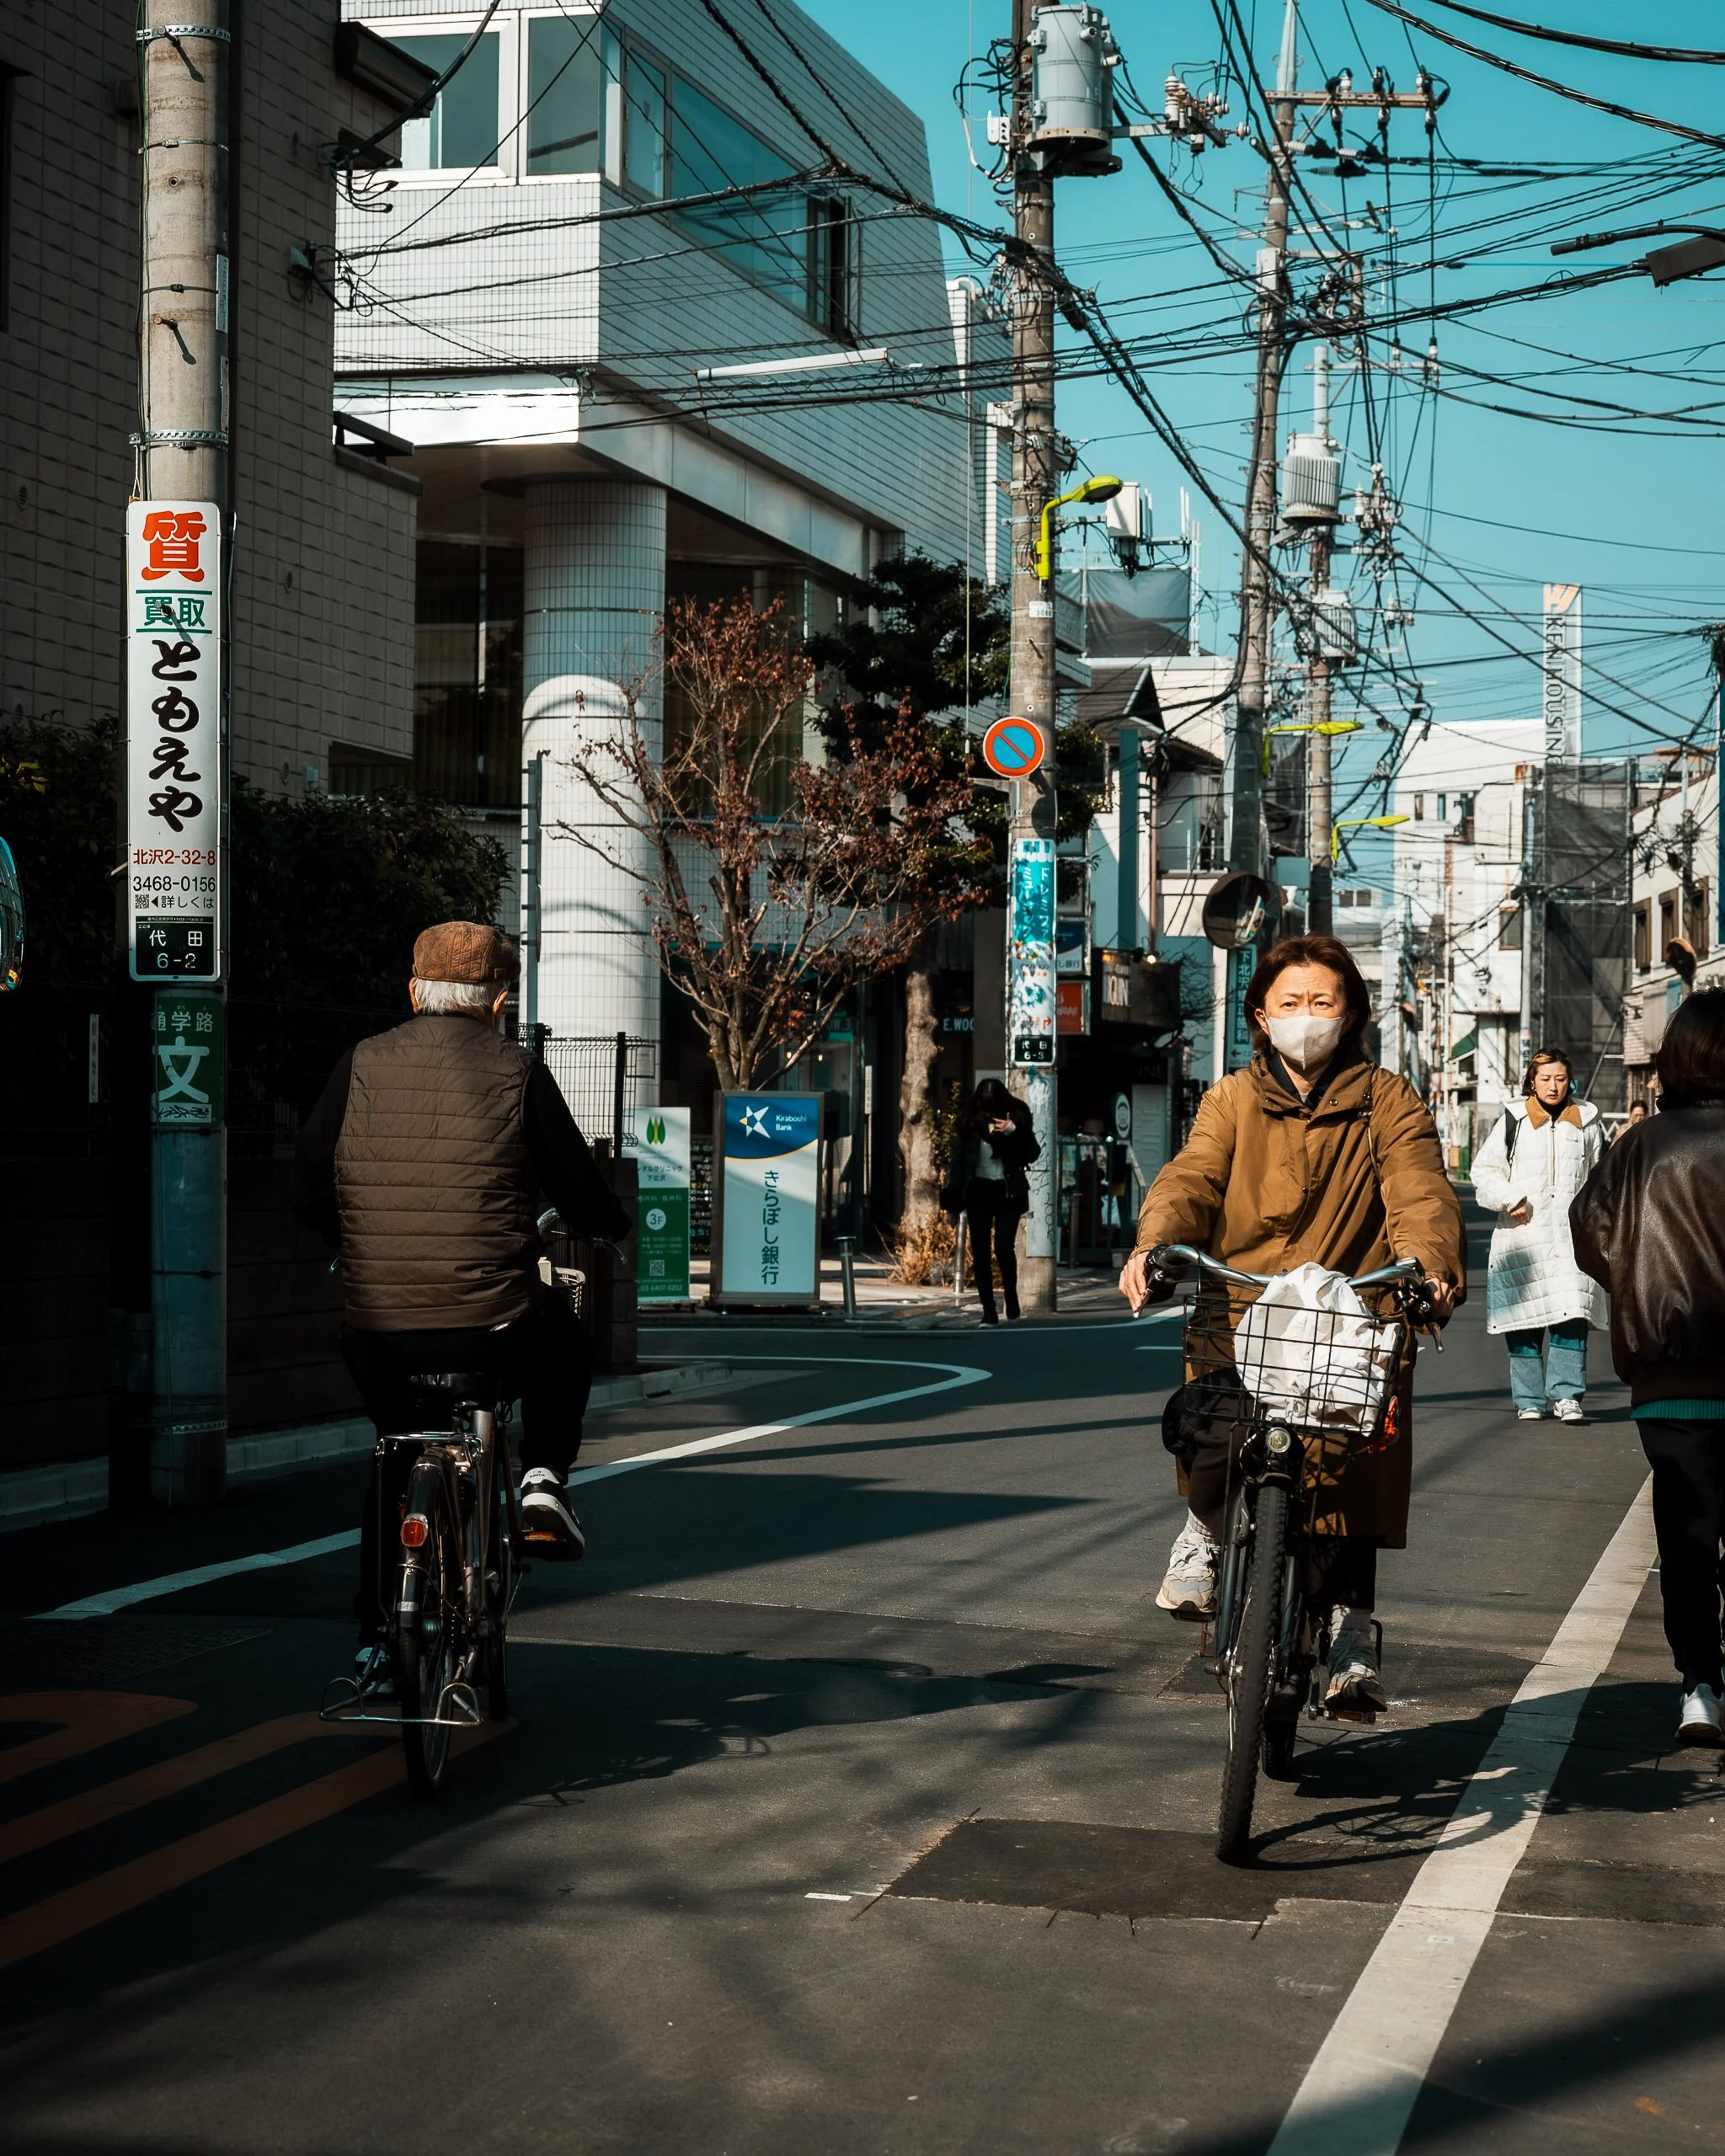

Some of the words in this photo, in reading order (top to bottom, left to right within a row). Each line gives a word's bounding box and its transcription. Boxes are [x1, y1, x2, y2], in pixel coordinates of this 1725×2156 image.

[141, 510, 207, 583] 質
[144, 596, 205, 627] 買取
[1546, 617, 1562, 659] KEN
[148, 639, 203, 832] ともえや
[133, 849, 216, 866] 北沢2-32-8
[133, 876, 216, 893] 3468-0156
[161, 895, 215, 909] 詳しくは
[149, 930, 202, 947] 代田
[157, 953, 196, 969] 6-2
[1023, 1050, 1044, 1060] 6-3
[776, 1114, 807, 1123] Kiraboshi
[649, 1214, 664, 1225] 3F
[761, 1170, 781, 1285] きらぼし銀行
